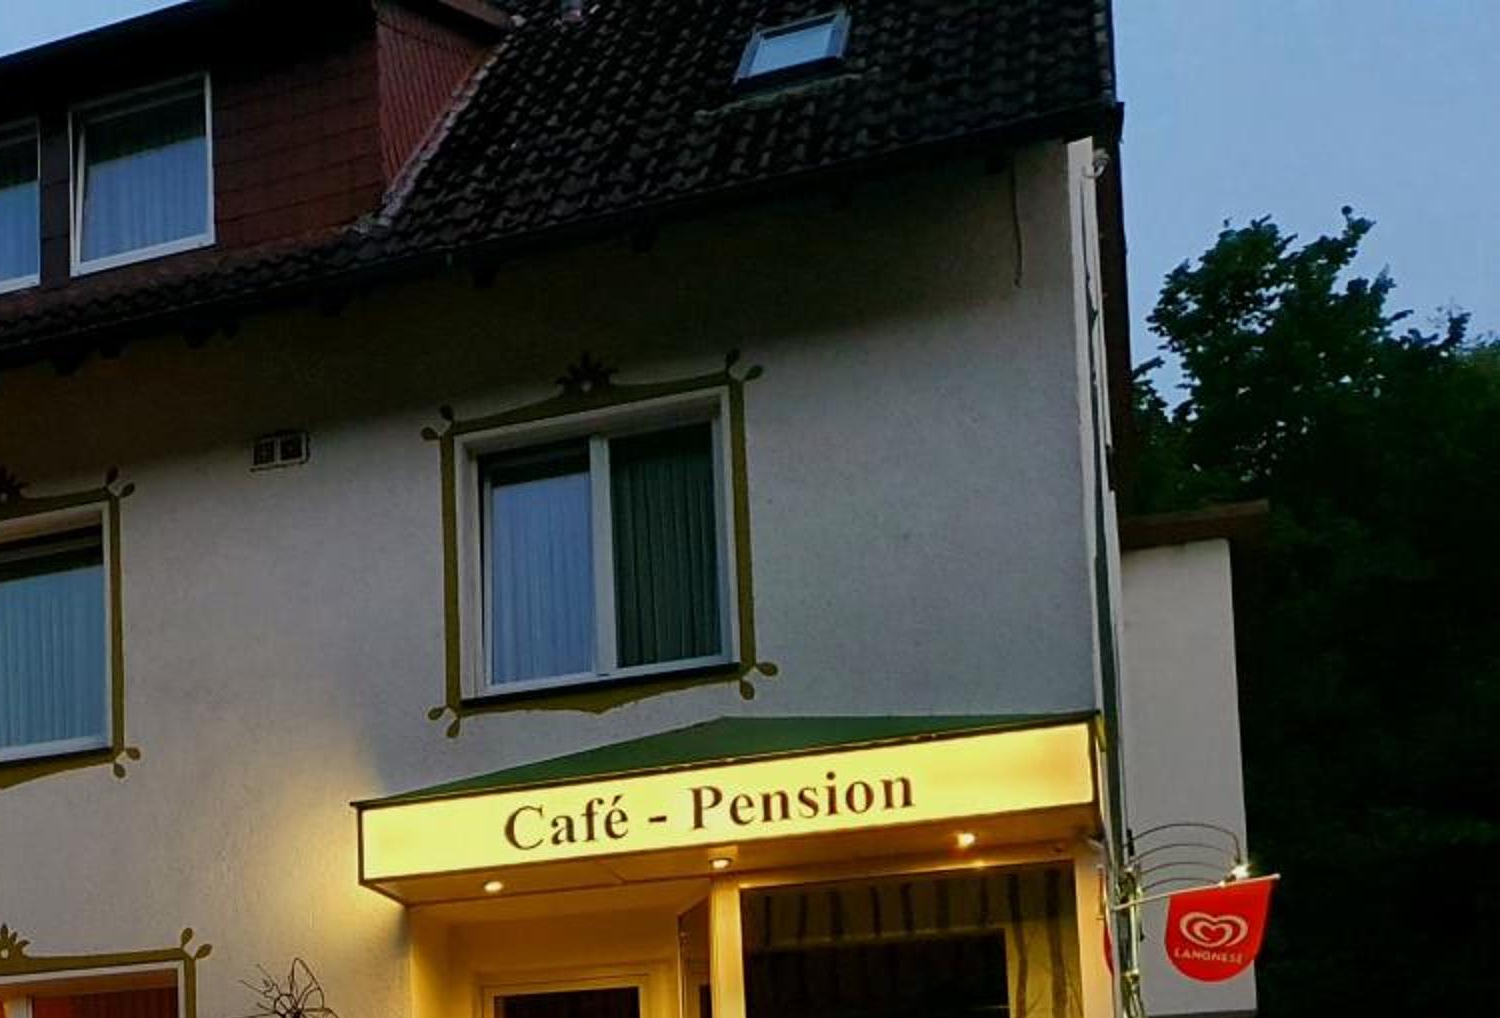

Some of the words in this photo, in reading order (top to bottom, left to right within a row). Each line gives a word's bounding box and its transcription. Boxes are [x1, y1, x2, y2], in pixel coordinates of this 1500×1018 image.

[504, 794, 629, 850] Café
[691, 771, 914, 830] Pension
[1173, 947, 1244, 965] LANGNESE
